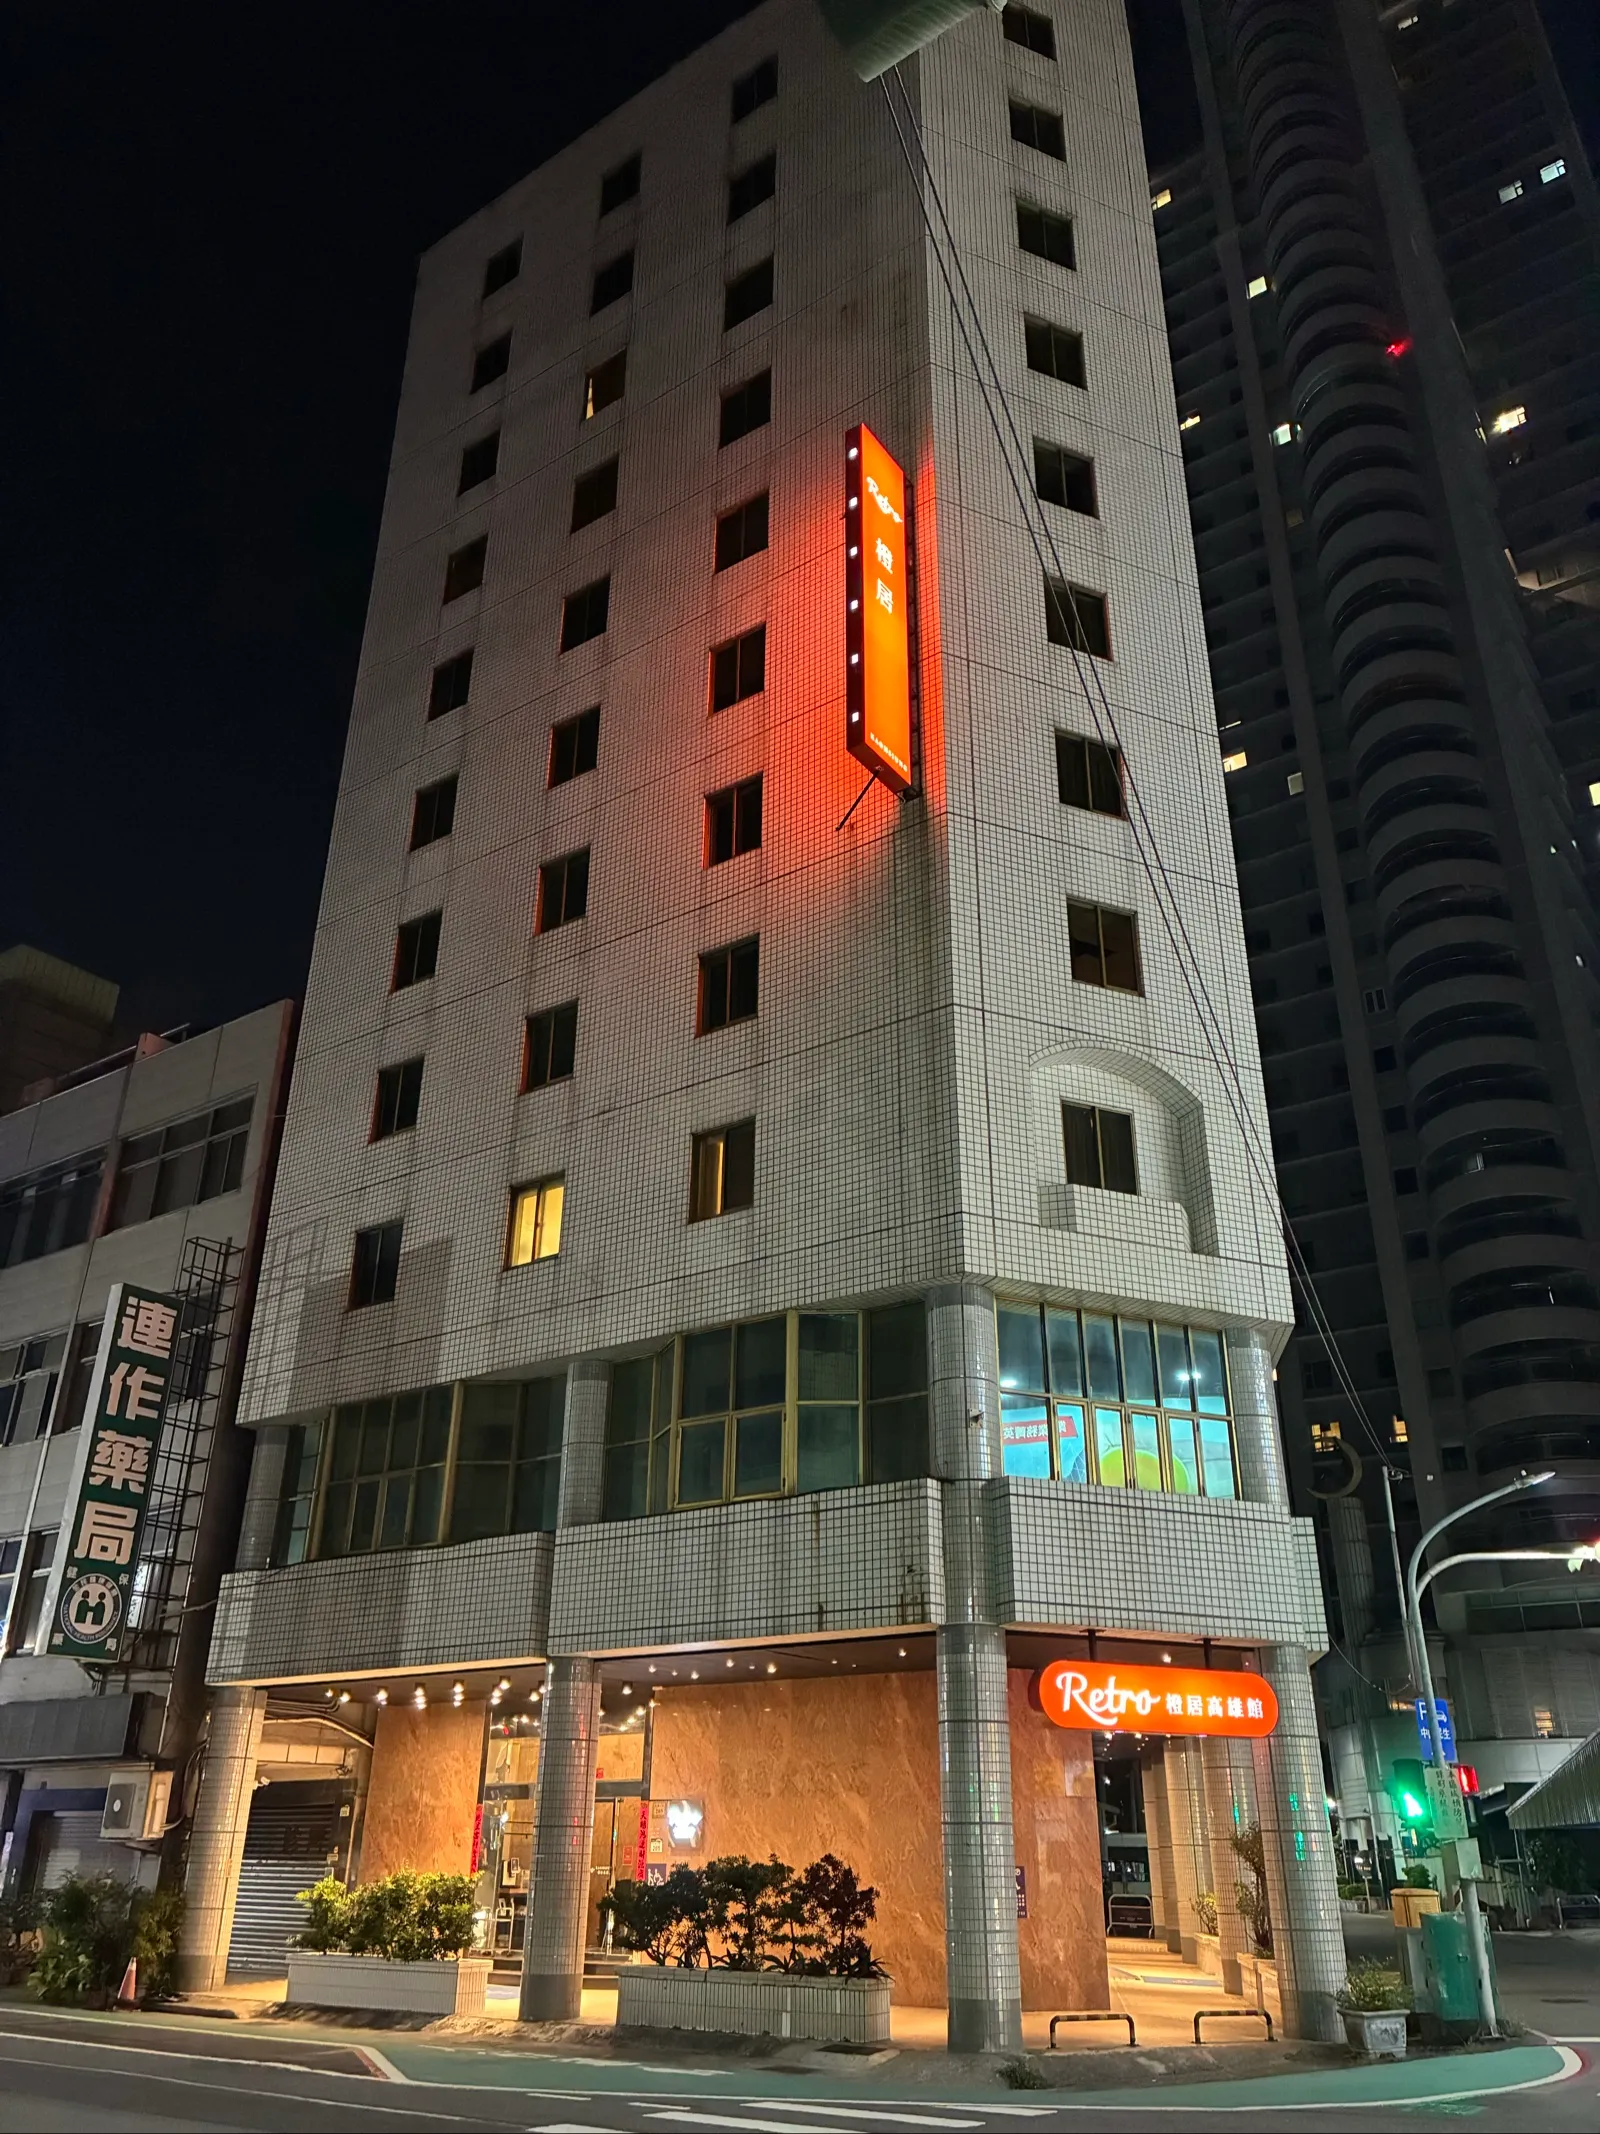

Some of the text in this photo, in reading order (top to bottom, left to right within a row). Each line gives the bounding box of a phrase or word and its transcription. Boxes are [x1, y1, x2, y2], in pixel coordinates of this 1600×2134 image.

[866, 476, 904, 524] Retro
[73, 1296, 178, 1566] 連作藥局
[1055, 1671, 1161, 1726] Retro
[1165, 1692, 1265, 1719] 橙居高雄館
